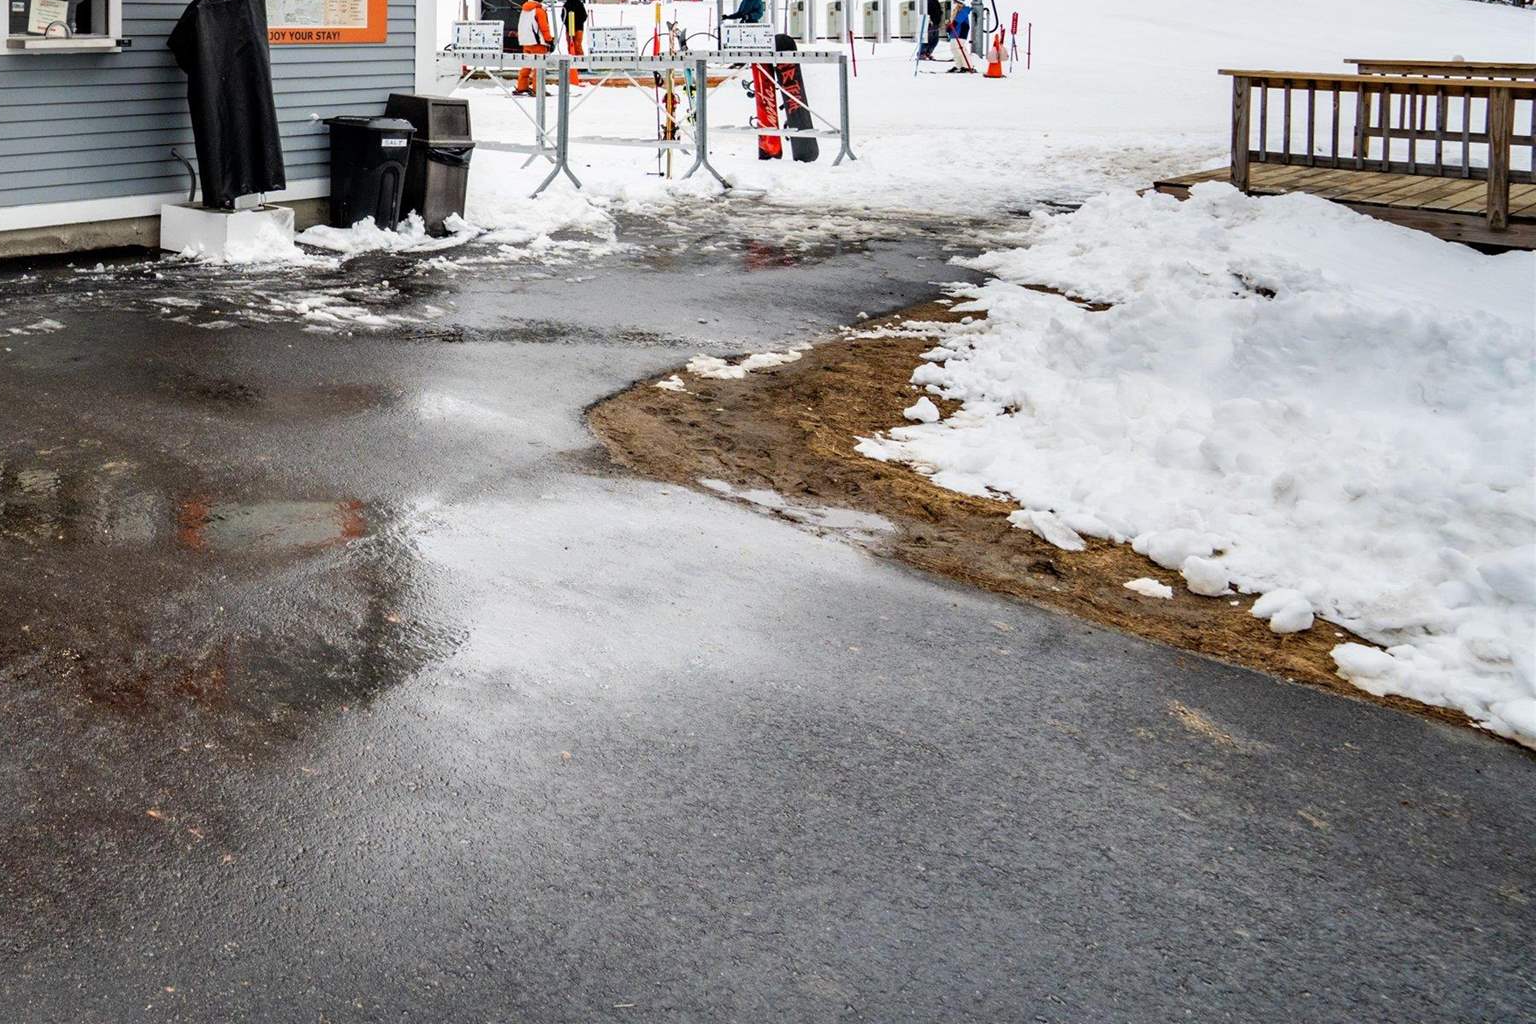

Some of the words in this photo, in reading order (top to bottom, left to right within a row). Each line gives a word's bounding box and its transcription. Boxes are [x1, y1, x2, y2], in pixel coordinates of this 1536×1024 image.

[270, 31, 286, 41] JOY
[289, 31, 313, 41] YOUR
[316, 31, 341, 41] STAY!
